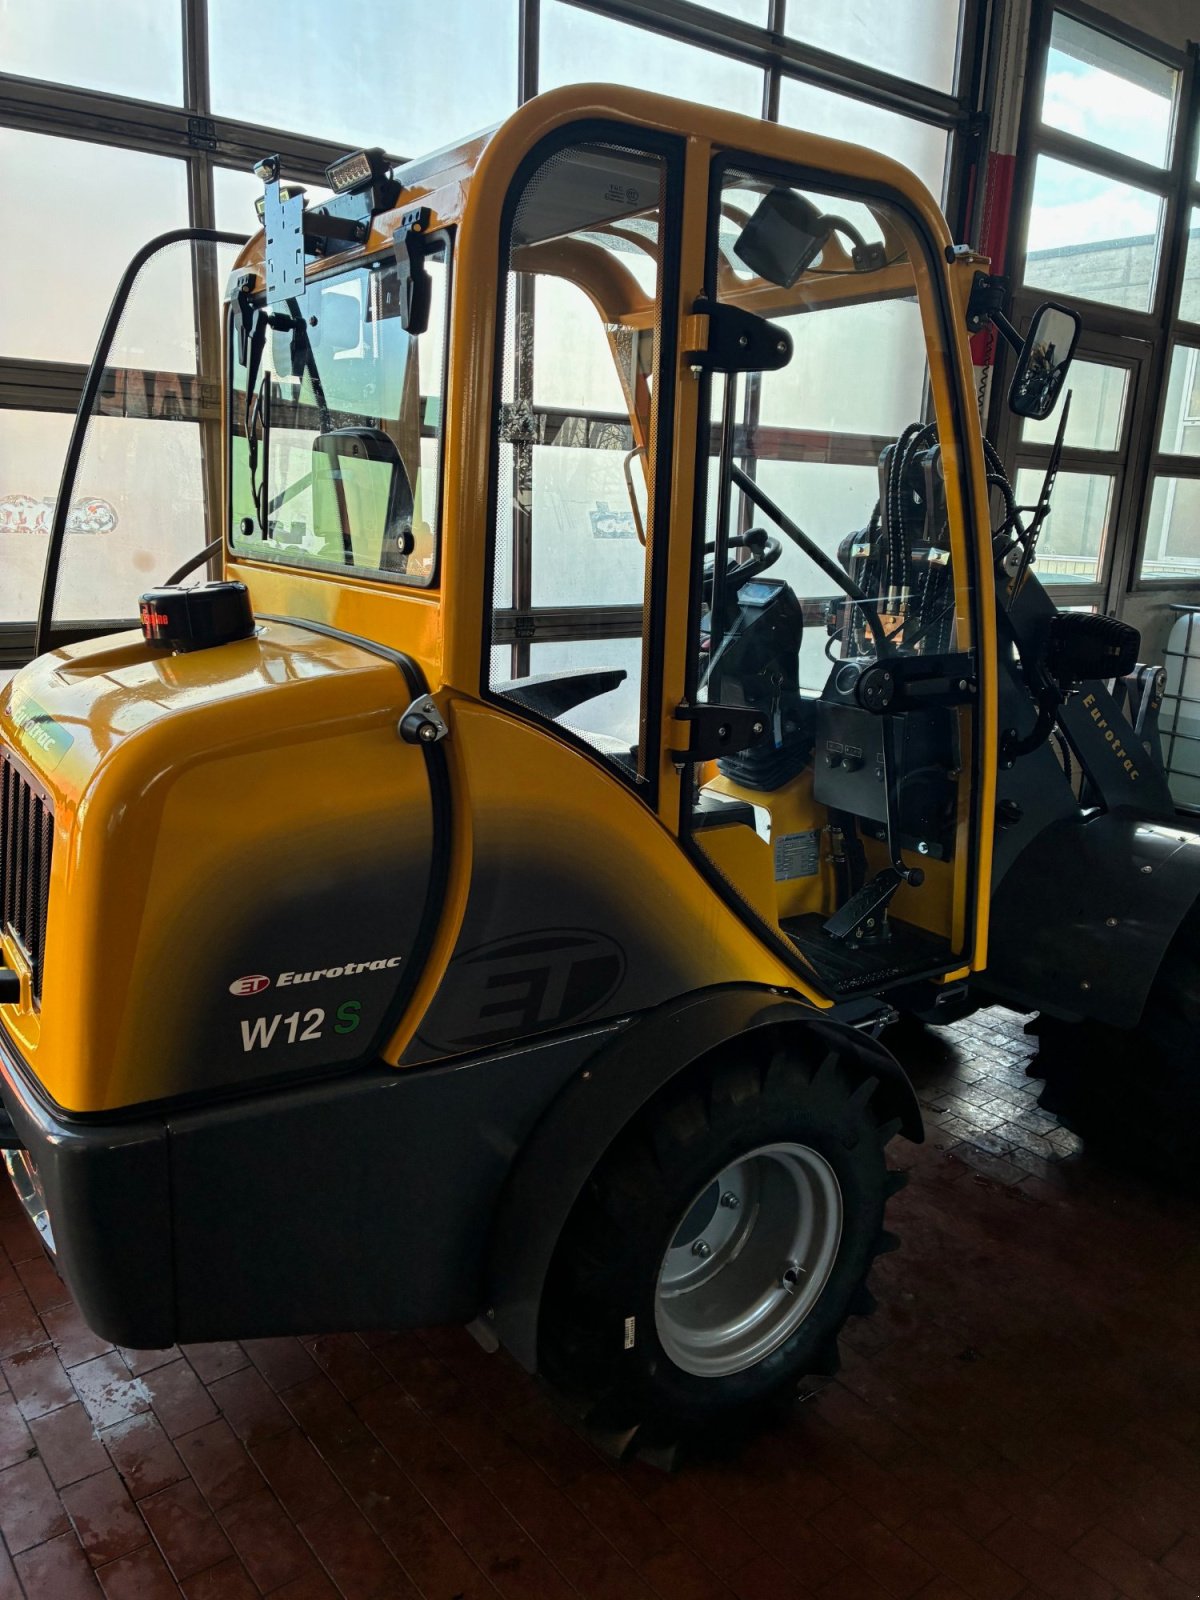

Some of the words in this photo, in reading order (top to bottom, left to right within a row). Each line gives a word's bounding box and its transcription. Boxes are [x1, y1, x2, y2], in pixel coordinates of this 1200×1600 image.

[1082, 693, 1140, 781] Eurotrac
[236, 975, 269, 994] ET
[276, 956, 402, 988] Eurotrac
[240, 1008, 326, 1052] W12
[333, 1000, 362, 1034] S
